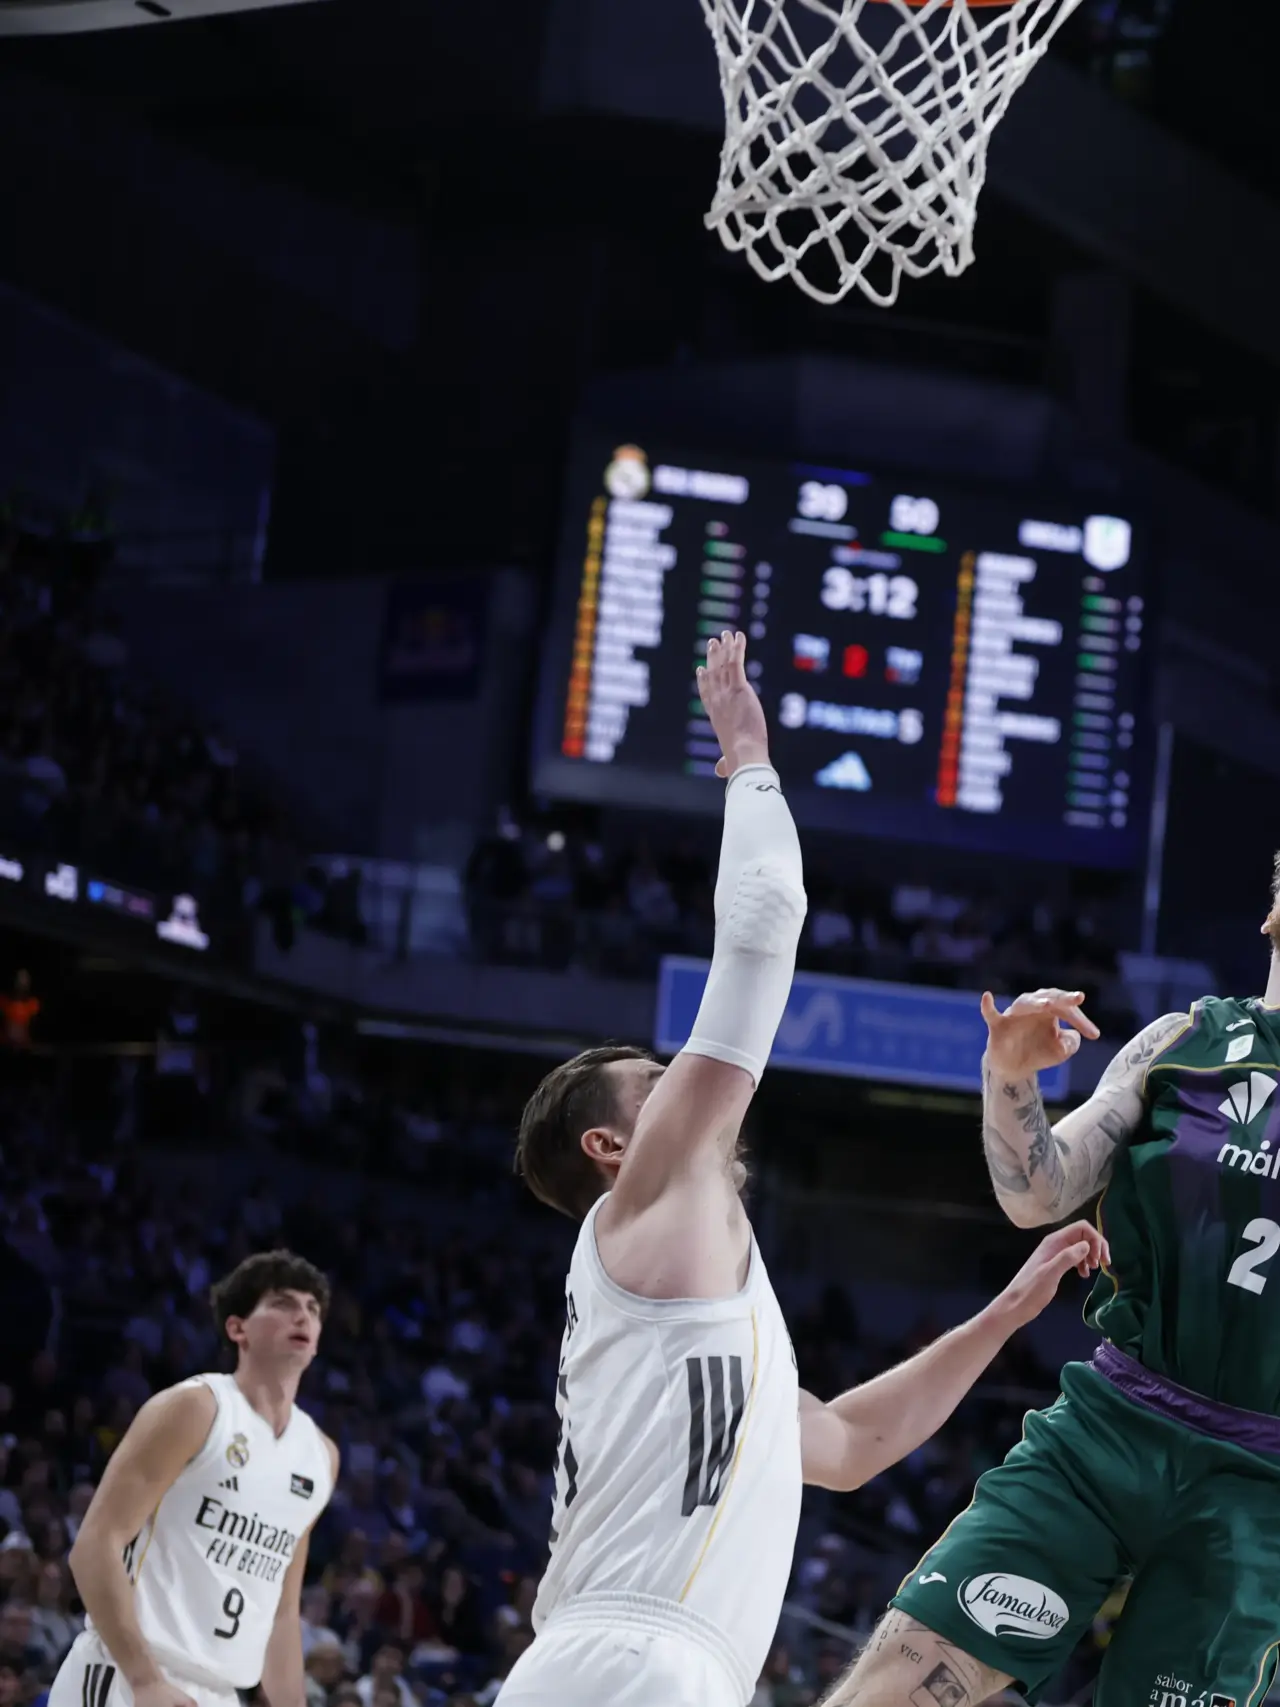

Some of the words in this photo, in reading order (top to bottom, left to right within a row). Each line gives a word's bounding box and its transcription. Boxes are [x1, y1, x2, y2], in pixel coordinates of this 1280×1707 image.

[822, 567, 918, 618] 3:12
[195, 1496, 297, 1557] Emirate
[206, 1538, 239, 1567] FLY
[237, 1548, 283, 1582] BETTER
[213, 1587, 245, 1640] 9
[966, 1575, 1067, 1629] famadesa
[899, 1643, 924, 1665] VICI
[1154, 1672, 1193, 1694] sabor
